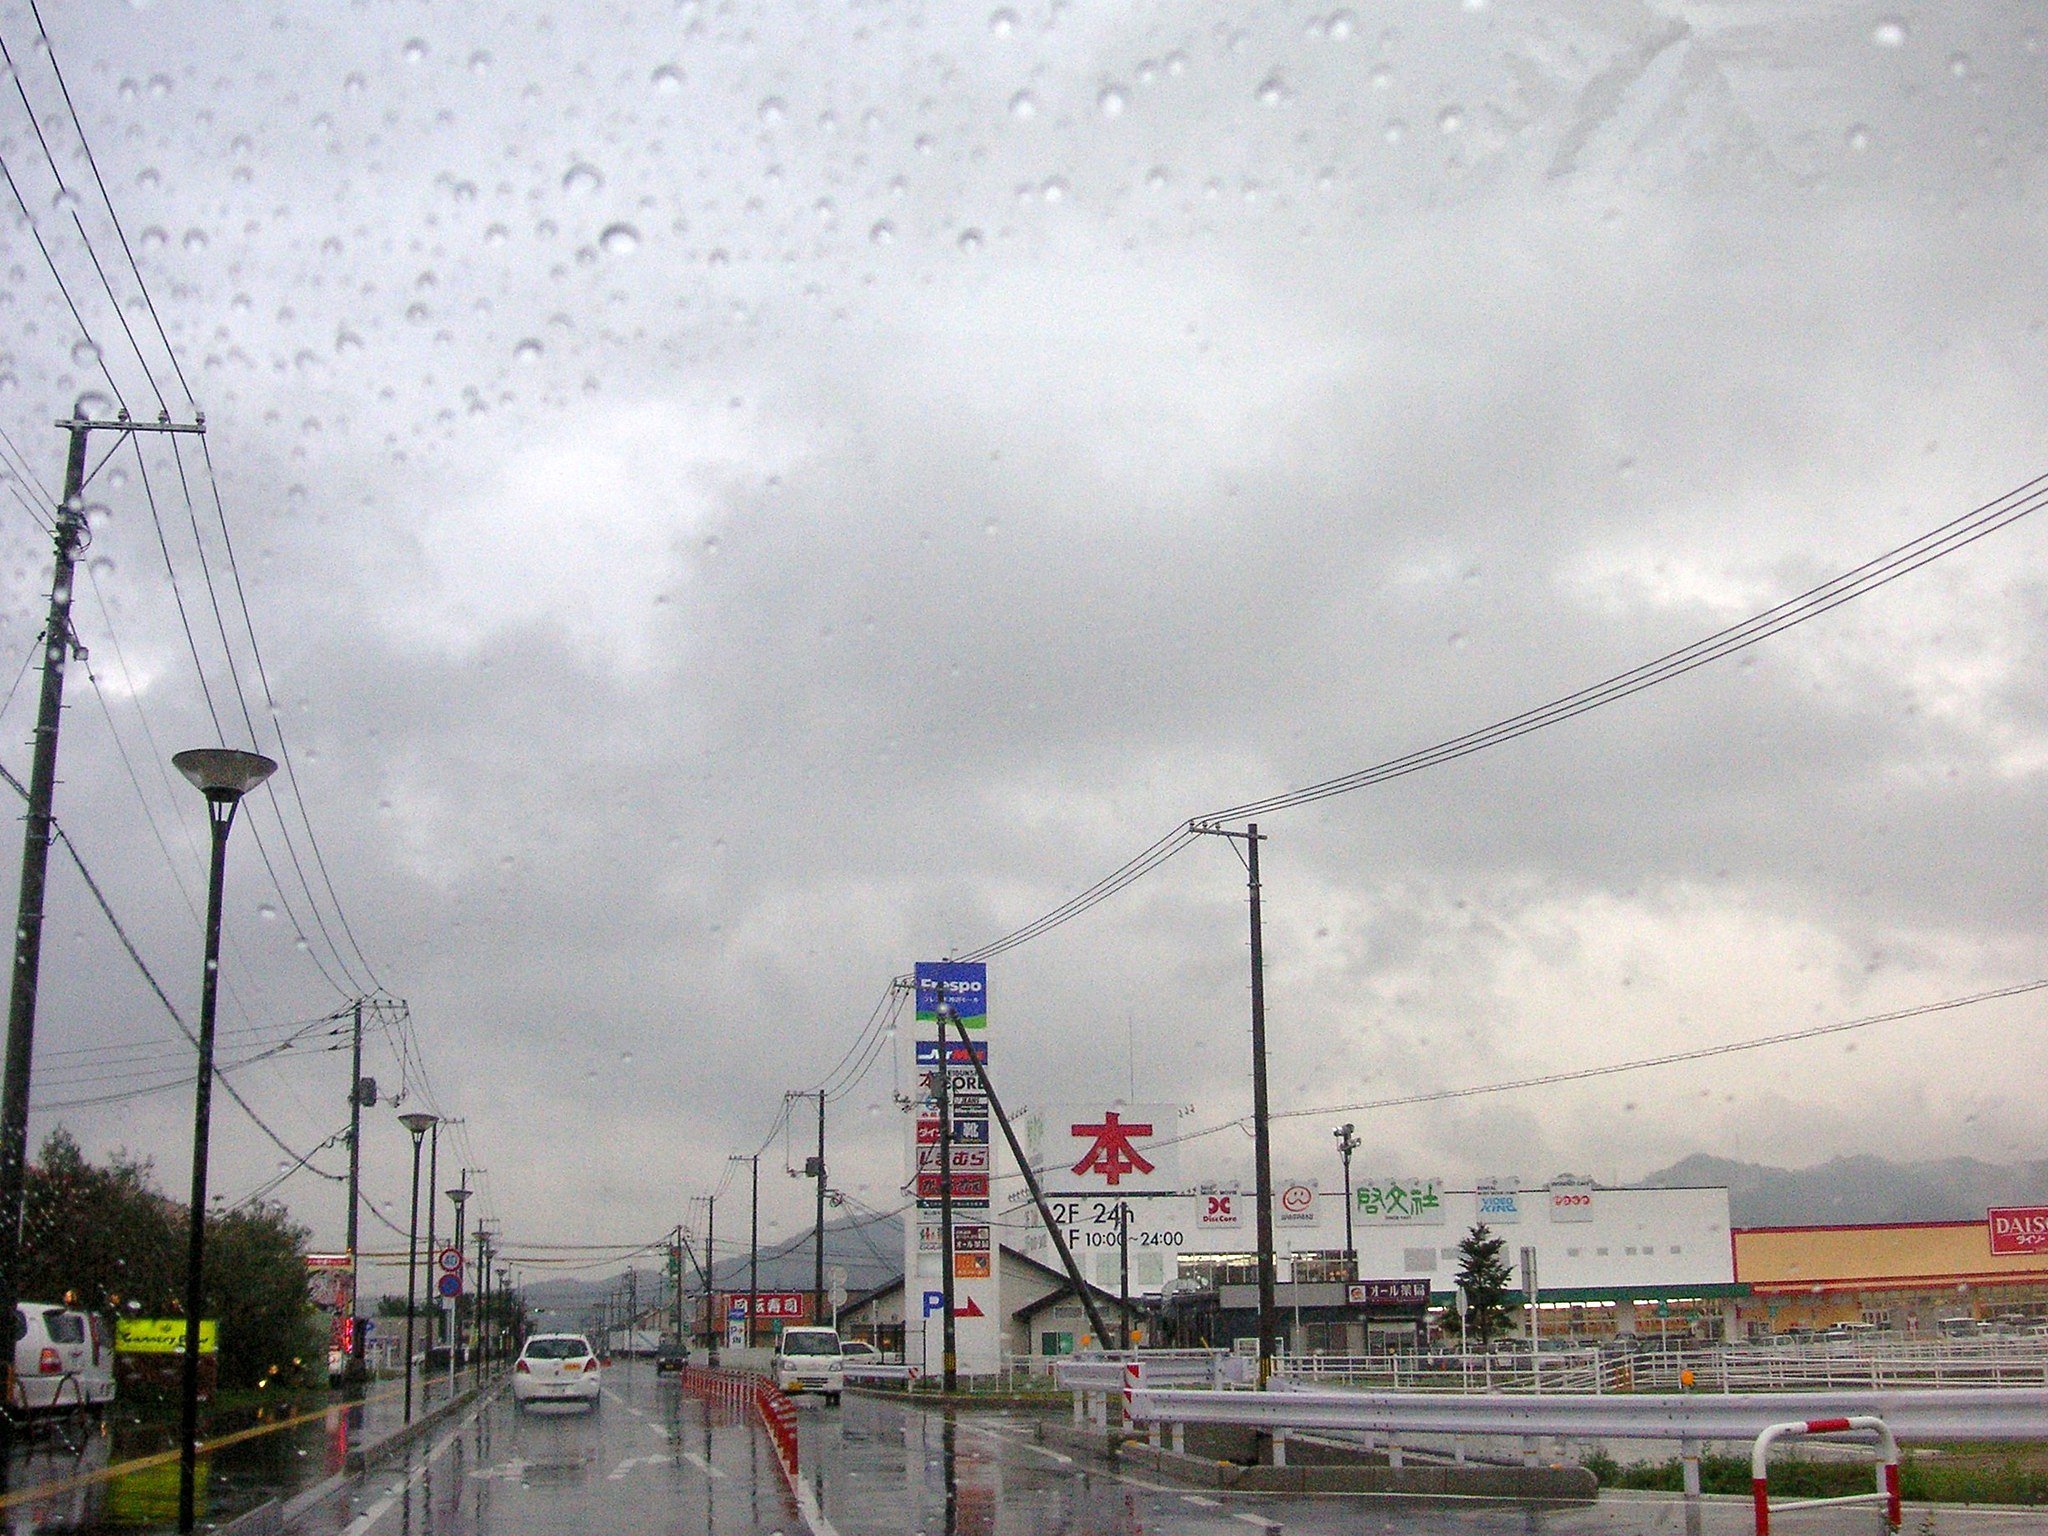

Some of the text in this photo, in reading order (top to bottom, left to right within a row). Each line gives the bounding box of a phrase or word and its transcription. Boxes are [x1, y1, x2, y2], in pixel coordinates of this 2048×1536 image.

[1071, 1111, 1155, 1185] 本
[1357, 1184, 1440, 1215] 啓文社
[1053, 1203, 1079, 1224] 2F
[1996, 1216, 2048, 1234] DAIS
[923, 1291, 944, 1317] P
